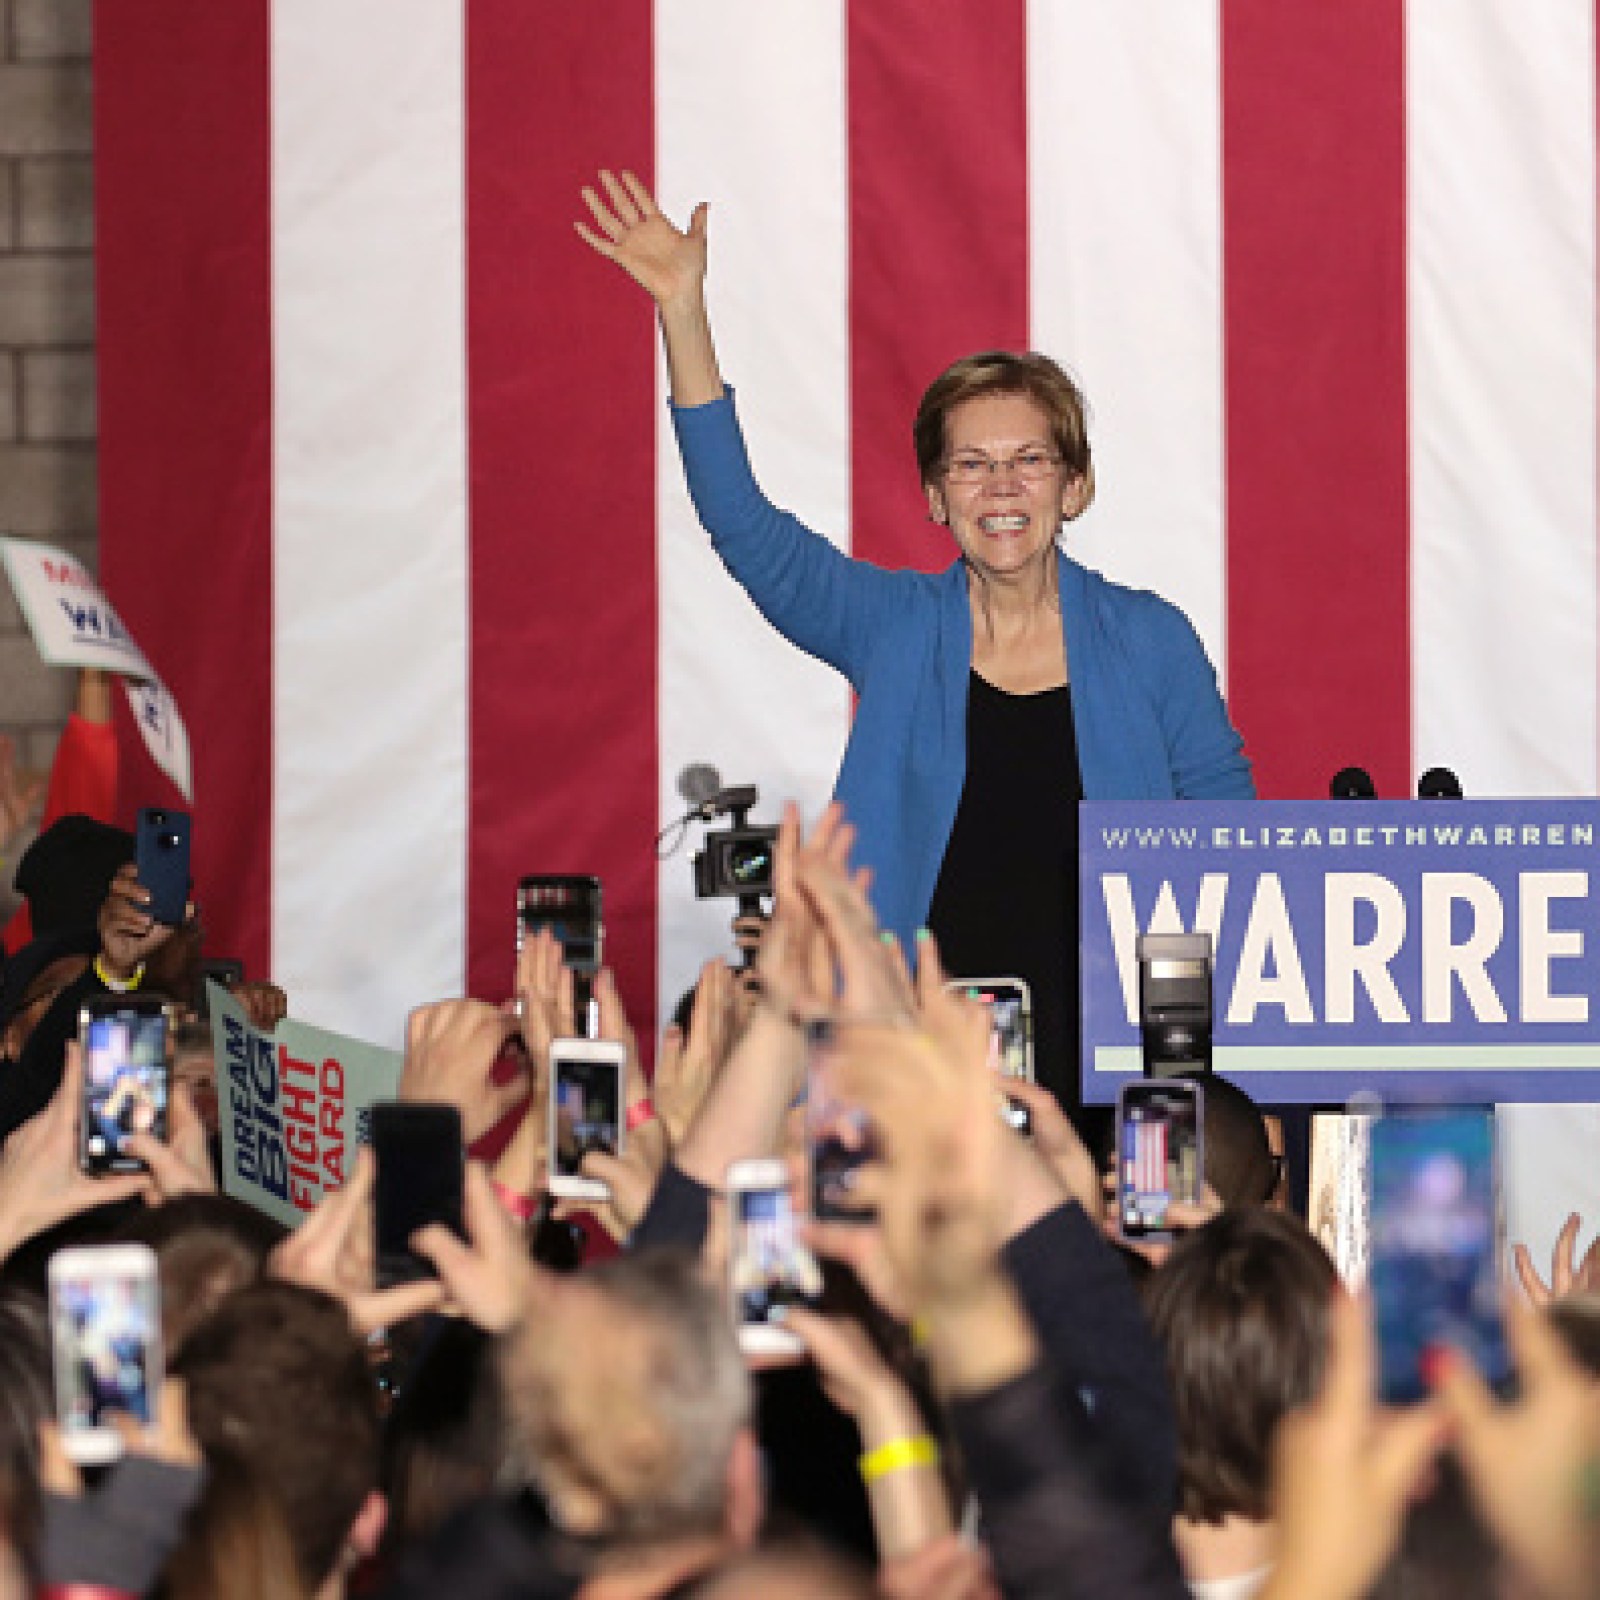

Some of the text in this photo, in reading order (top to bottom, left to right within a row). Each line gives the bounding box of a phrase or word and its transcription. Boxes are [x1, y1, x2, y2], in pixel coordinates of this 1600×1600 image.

[222, 1014, 259, 1184] DREAM
[246, 1033, 288, 1201] BIG
[278, 1043, 320, 1213] FIGHT
